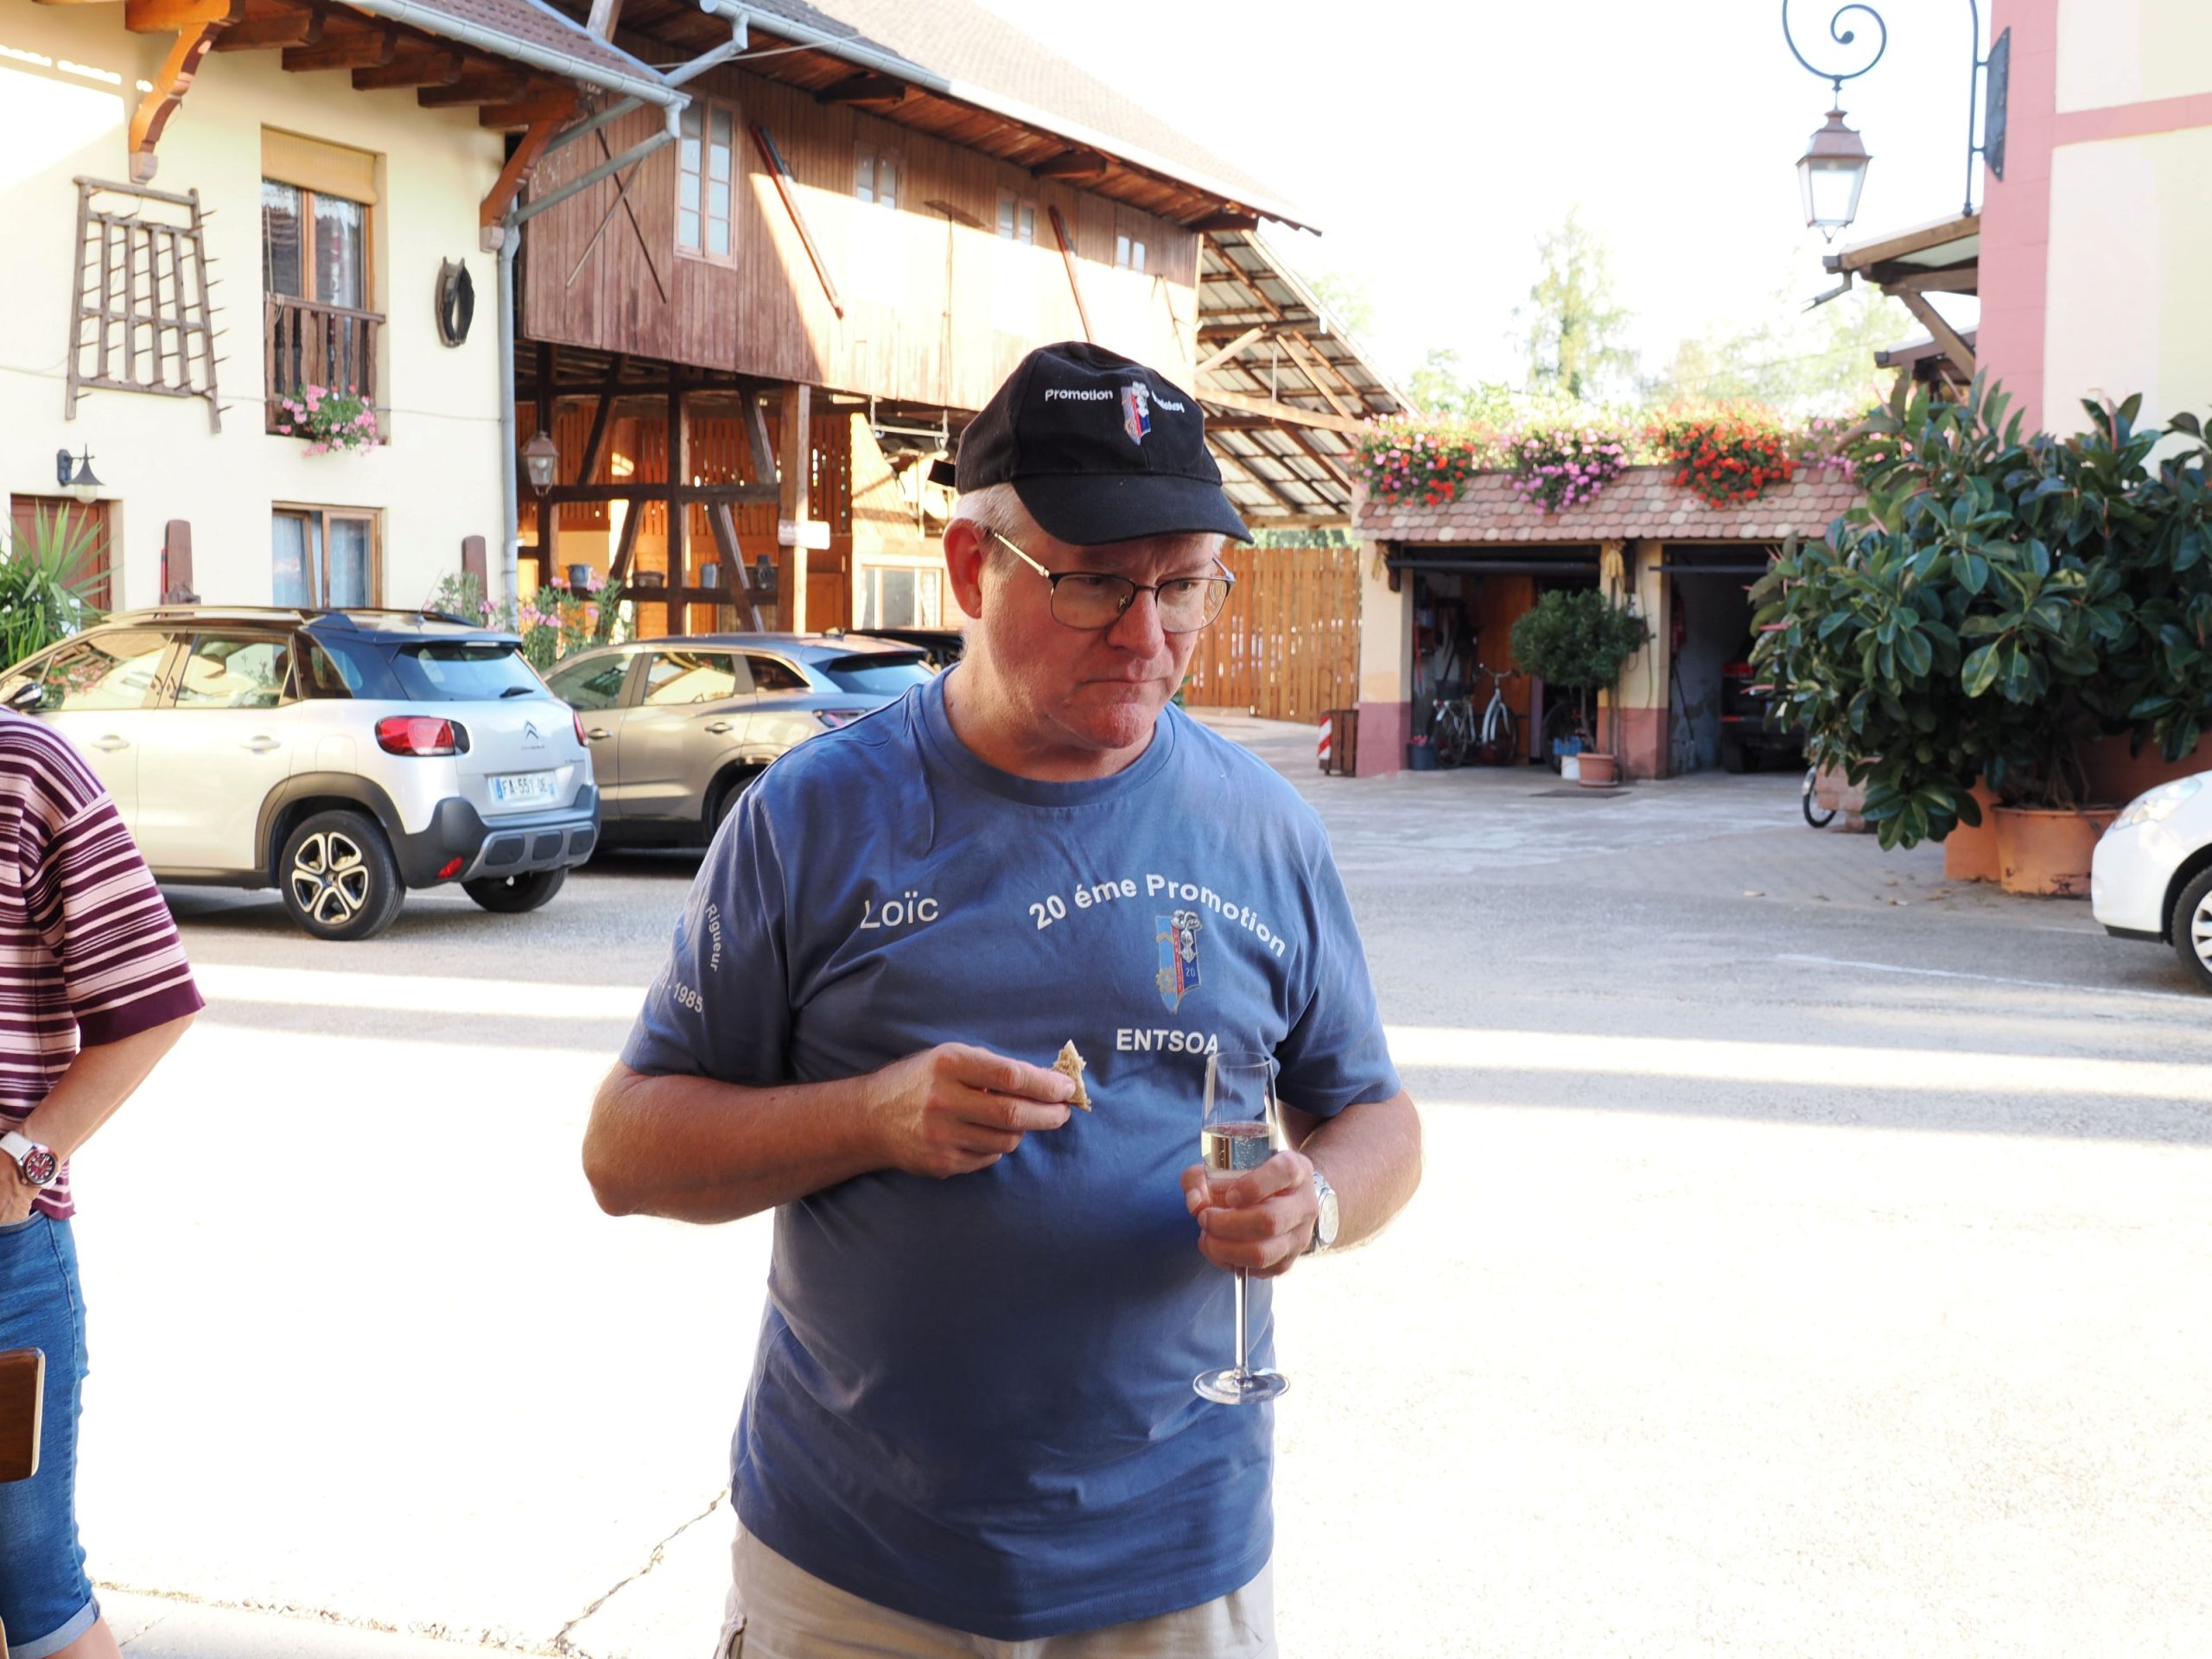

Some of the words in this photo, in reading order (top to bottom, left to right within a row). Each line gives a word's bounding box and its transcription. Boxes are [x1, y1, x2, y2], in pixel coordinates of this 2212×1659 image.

[860, 890, 938, 929] Loïc
[1029, 895, 1067, 931] 20
[1074, 878, 1137, 908] éme
[1146, 874, 1286, 957] Promotion
[705, 903, 721, 973] Rigueur
[1185, 967, 1196, 977] 20
[674, 982, 703, 1013] 1985
[1116, 1028, 1218, 1055] ENTSOA
